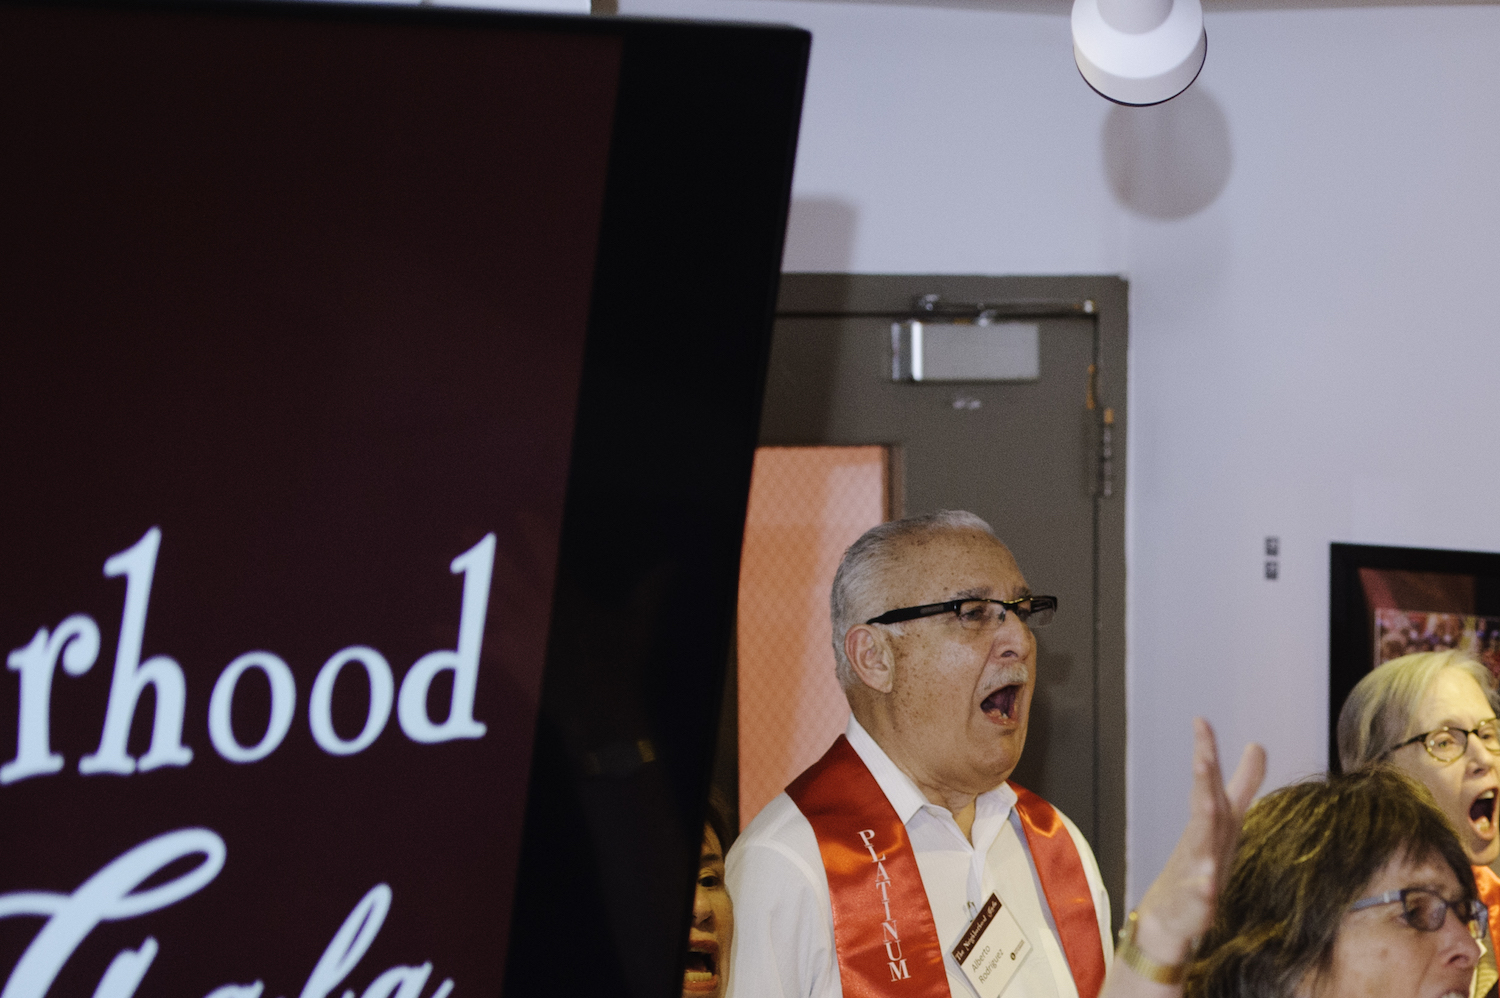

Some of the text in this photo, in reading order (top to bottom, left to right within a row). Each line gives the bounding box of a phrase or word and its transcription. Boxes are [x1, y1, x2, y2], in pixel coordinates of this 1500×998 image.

[0, 527, 496, 784] rhood
[858, 829, 911, 982] PLATINUM
[971, 945, 991, 973] Alberto
[978, 949, 1004, 984] Rodriguez
